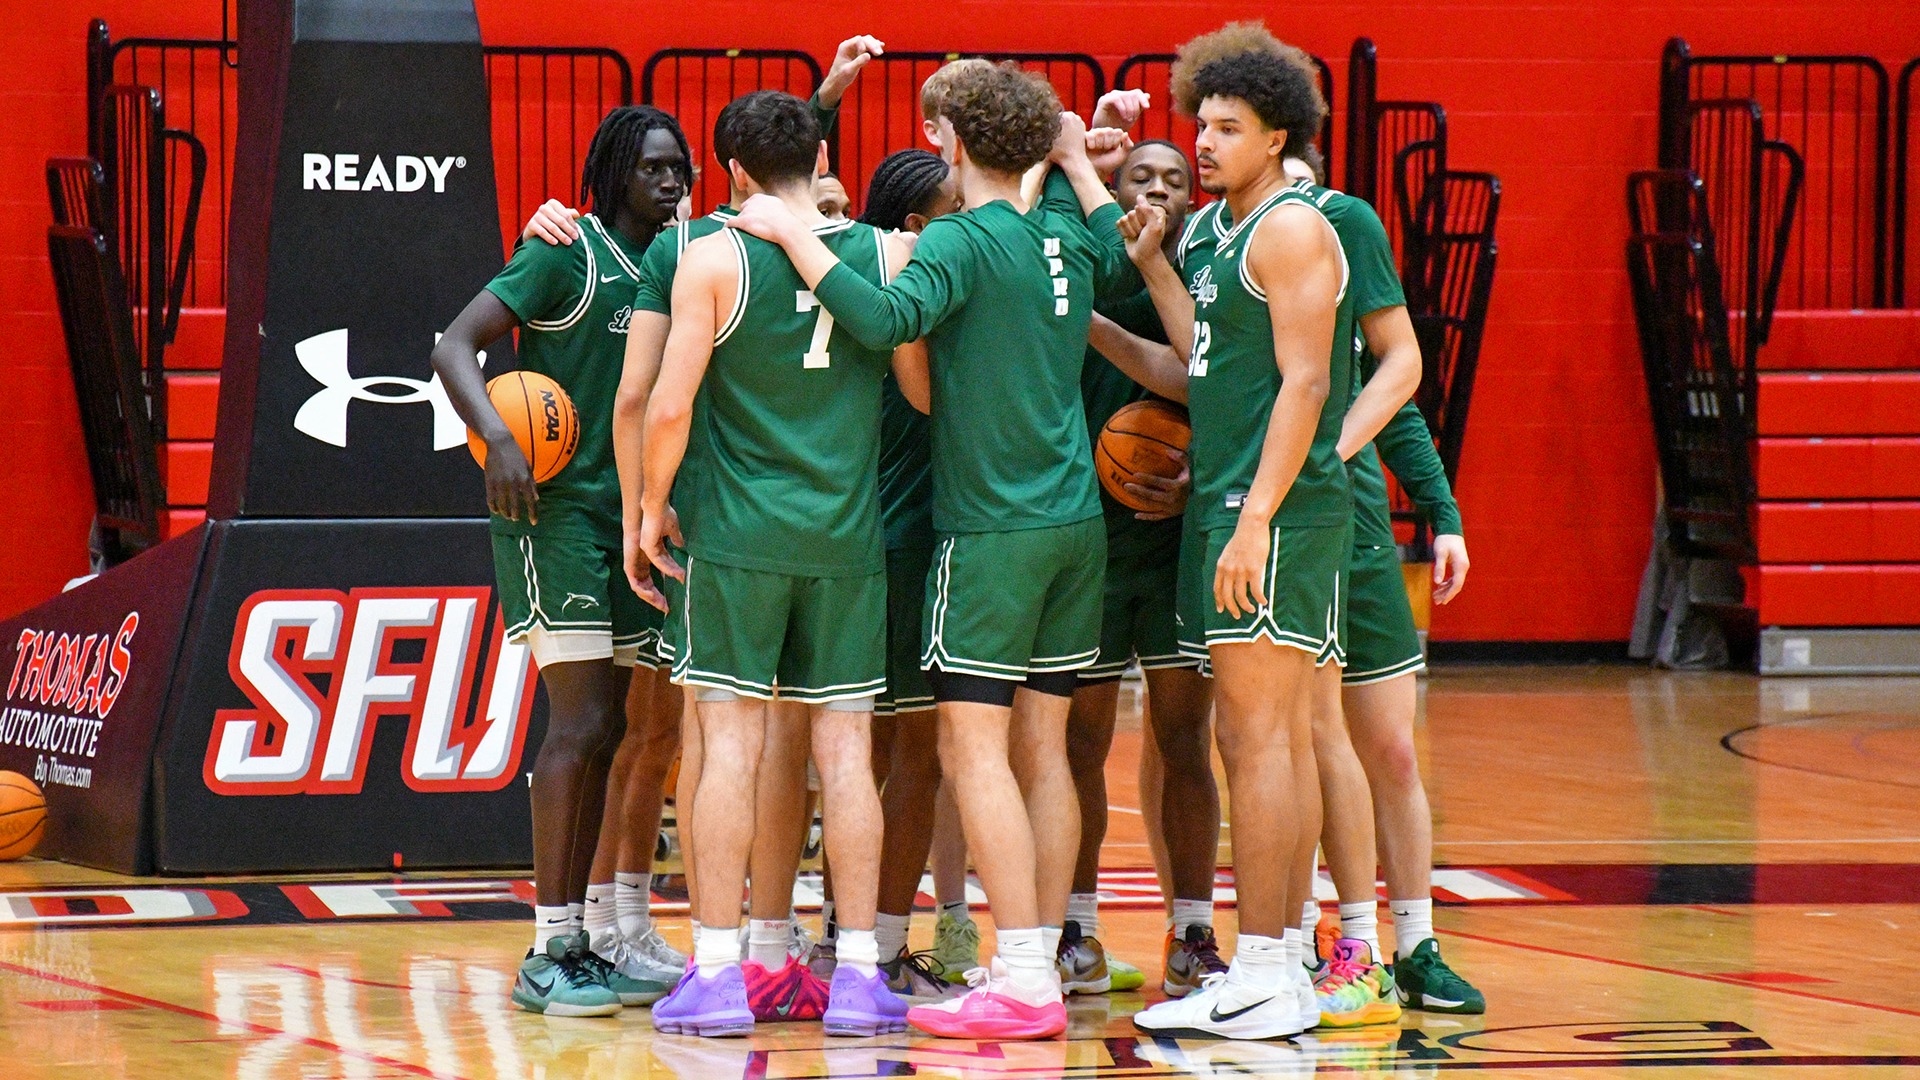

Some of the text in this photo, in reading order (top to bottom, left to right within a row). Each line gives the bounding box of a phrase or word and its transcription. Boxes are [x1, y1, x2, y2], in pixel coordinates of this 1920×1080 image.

[796, 290, 834, 369] 7
[540, 390, 560, 442] NCAA
[7, 611, 140, 719] THOMAS
[203, 586, 540, 795] SFU
[0, 707, 103, 758] AUTOMOTIVE
[34, 755, 92, 788] Buy Thomas.com
